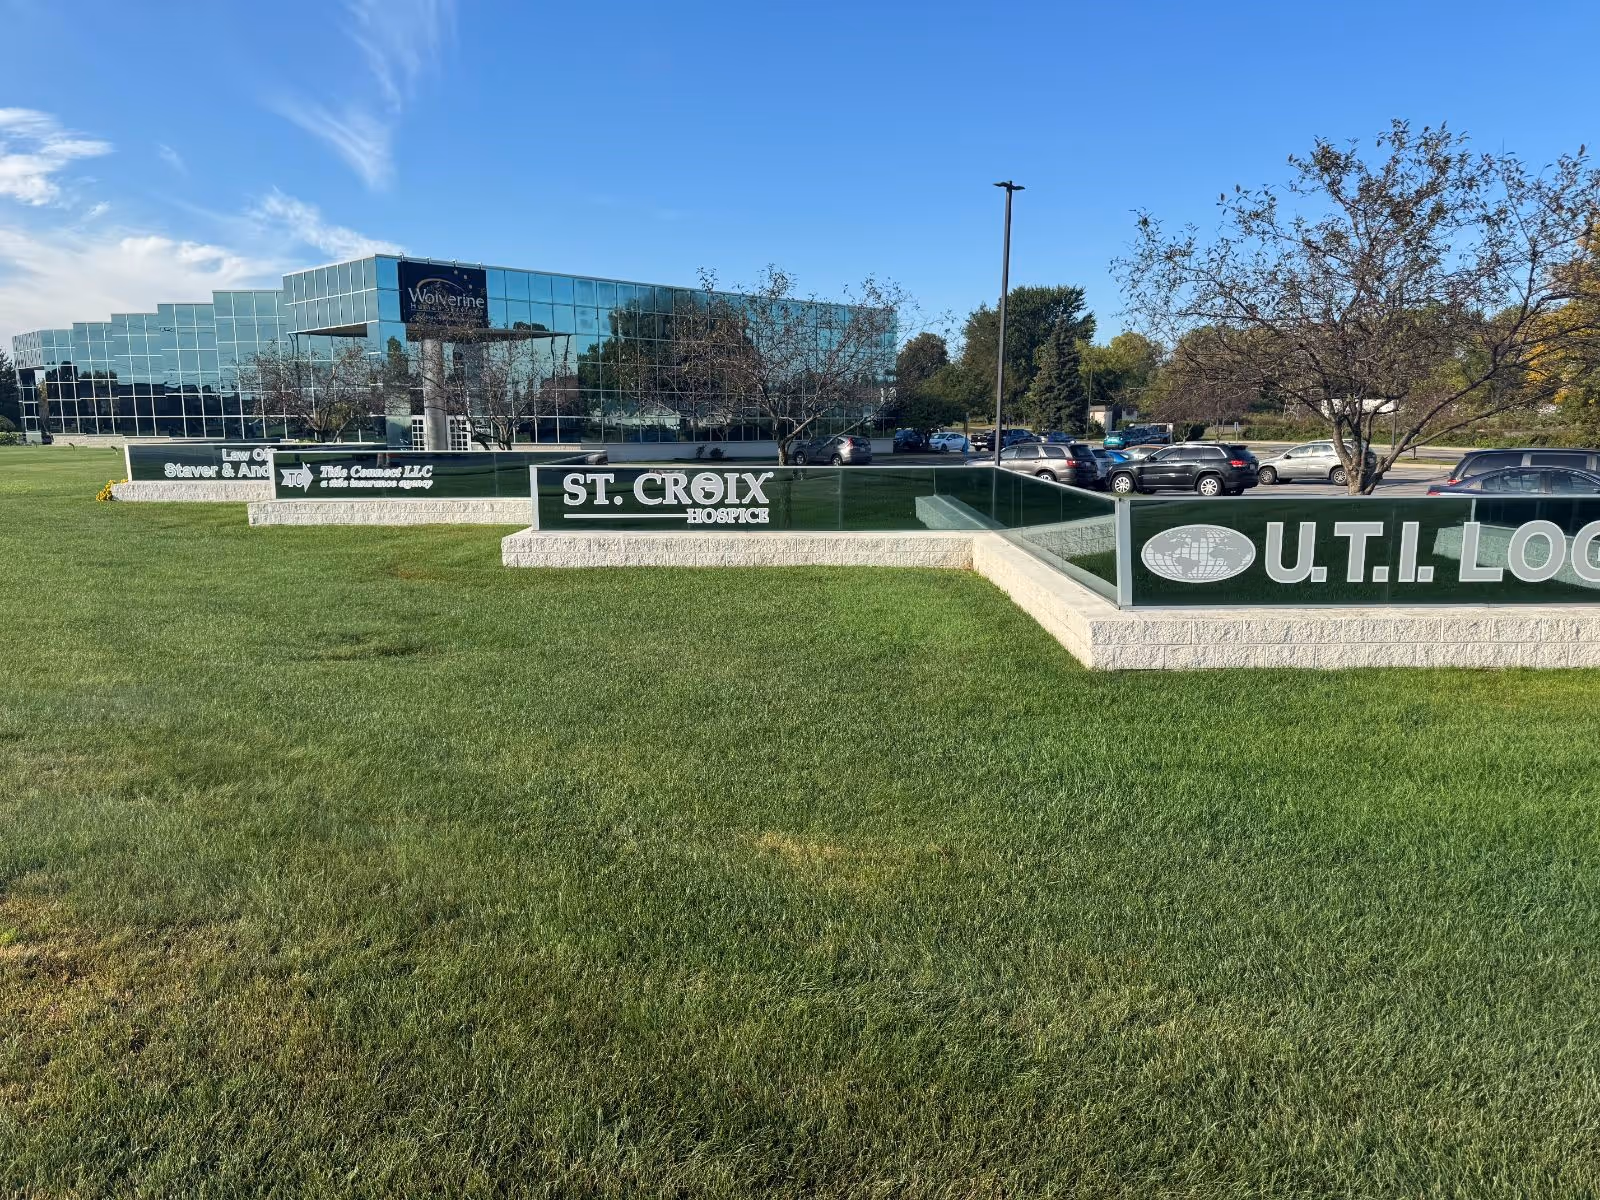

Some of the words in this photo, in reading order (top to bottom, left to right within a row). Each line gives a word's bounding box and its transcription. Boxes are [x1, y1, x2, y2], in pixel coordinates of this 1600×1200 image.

[408, 288, 485, 309] Wolverine
[221, 448, 250, 461] Law
[164, 462, 219, 478] Staver
[221, 462, 236, 478] &
[319, 465, 348, 478] Title
[350, 465, 402, 478] Connect
[402, 465, 434, 478] LLC
[289, 472, 303, 487] TC
[563, 473, 623, 506] ST.
[633, 472, 774, 506] CROIX
[686, 508, 770, 524] HOSPICE
[1264, 521, 1434, 583] U.T.I.
